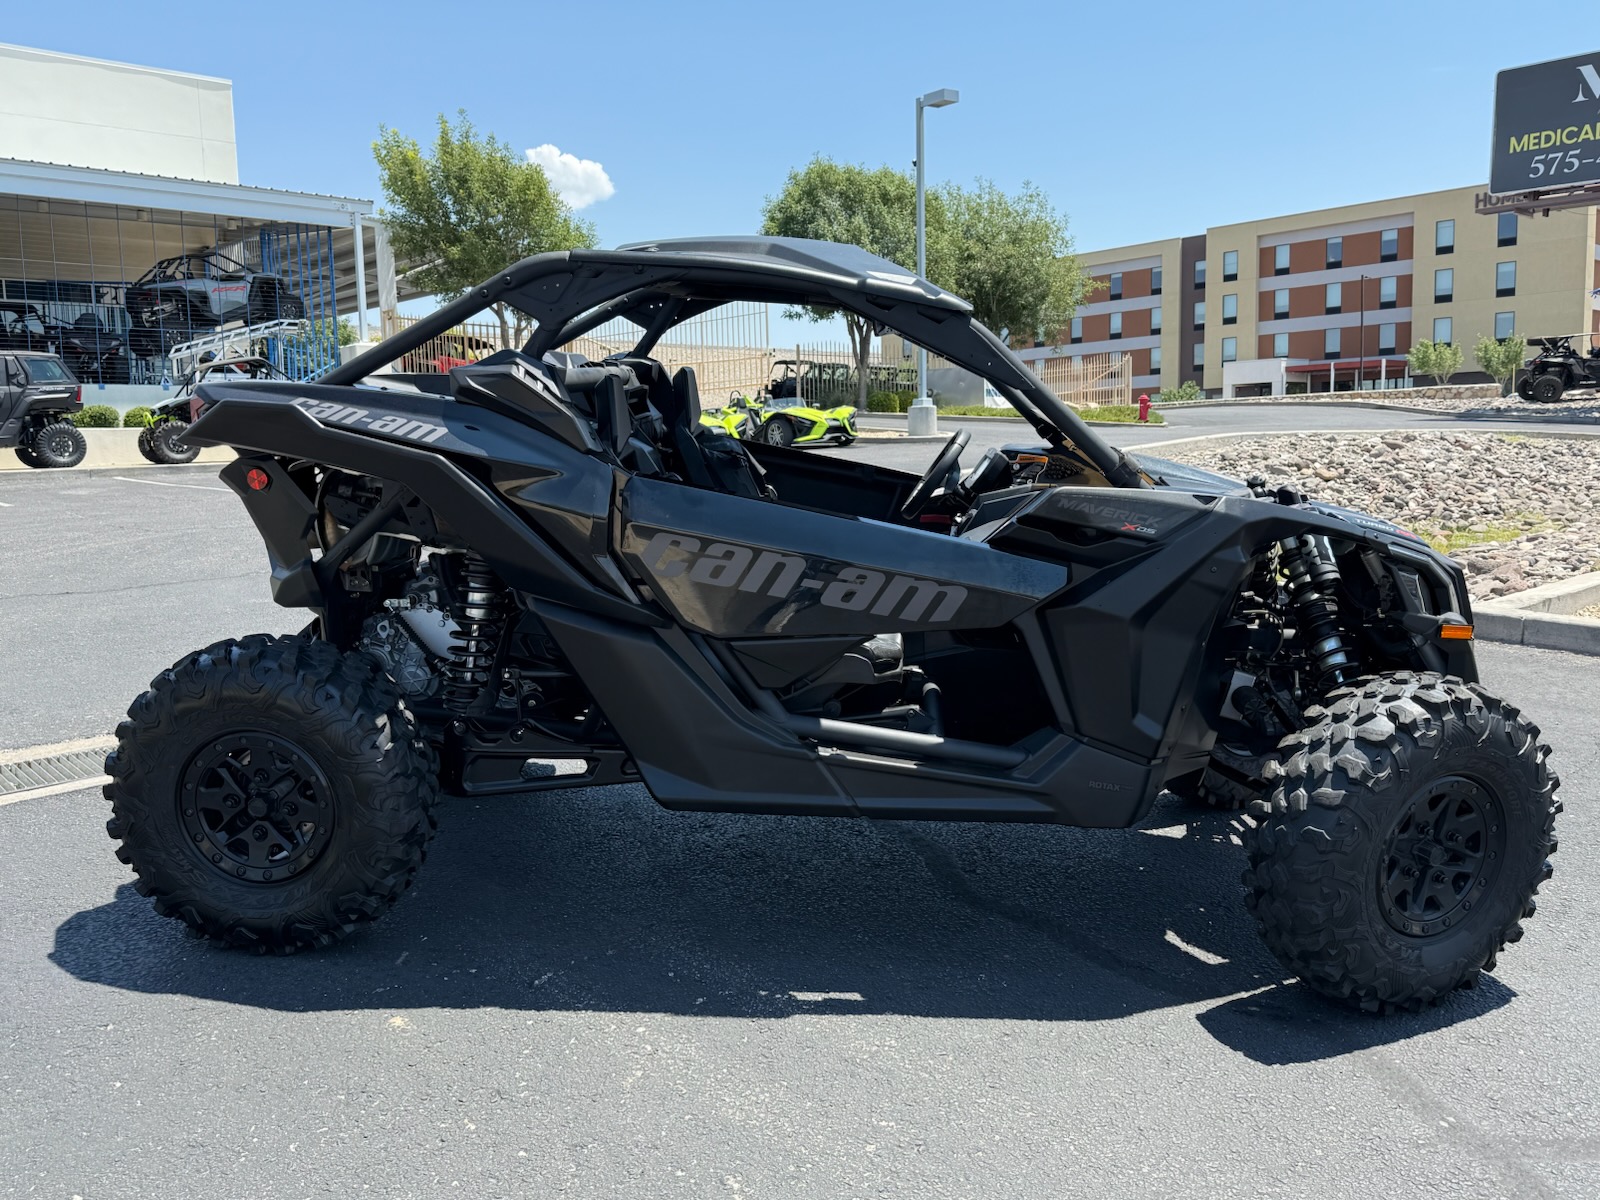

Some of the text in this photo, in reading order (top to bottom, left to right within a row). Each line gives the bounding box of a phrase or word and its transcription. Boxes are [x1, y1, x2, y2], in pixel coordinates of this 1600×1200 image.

[289, 397, 449, 443] can-am
[1057, 499, 1164, 528] MAVERICK
[641, 532, 968, 622] can-am
[1088, 780, 1120, 791] ROTAX
